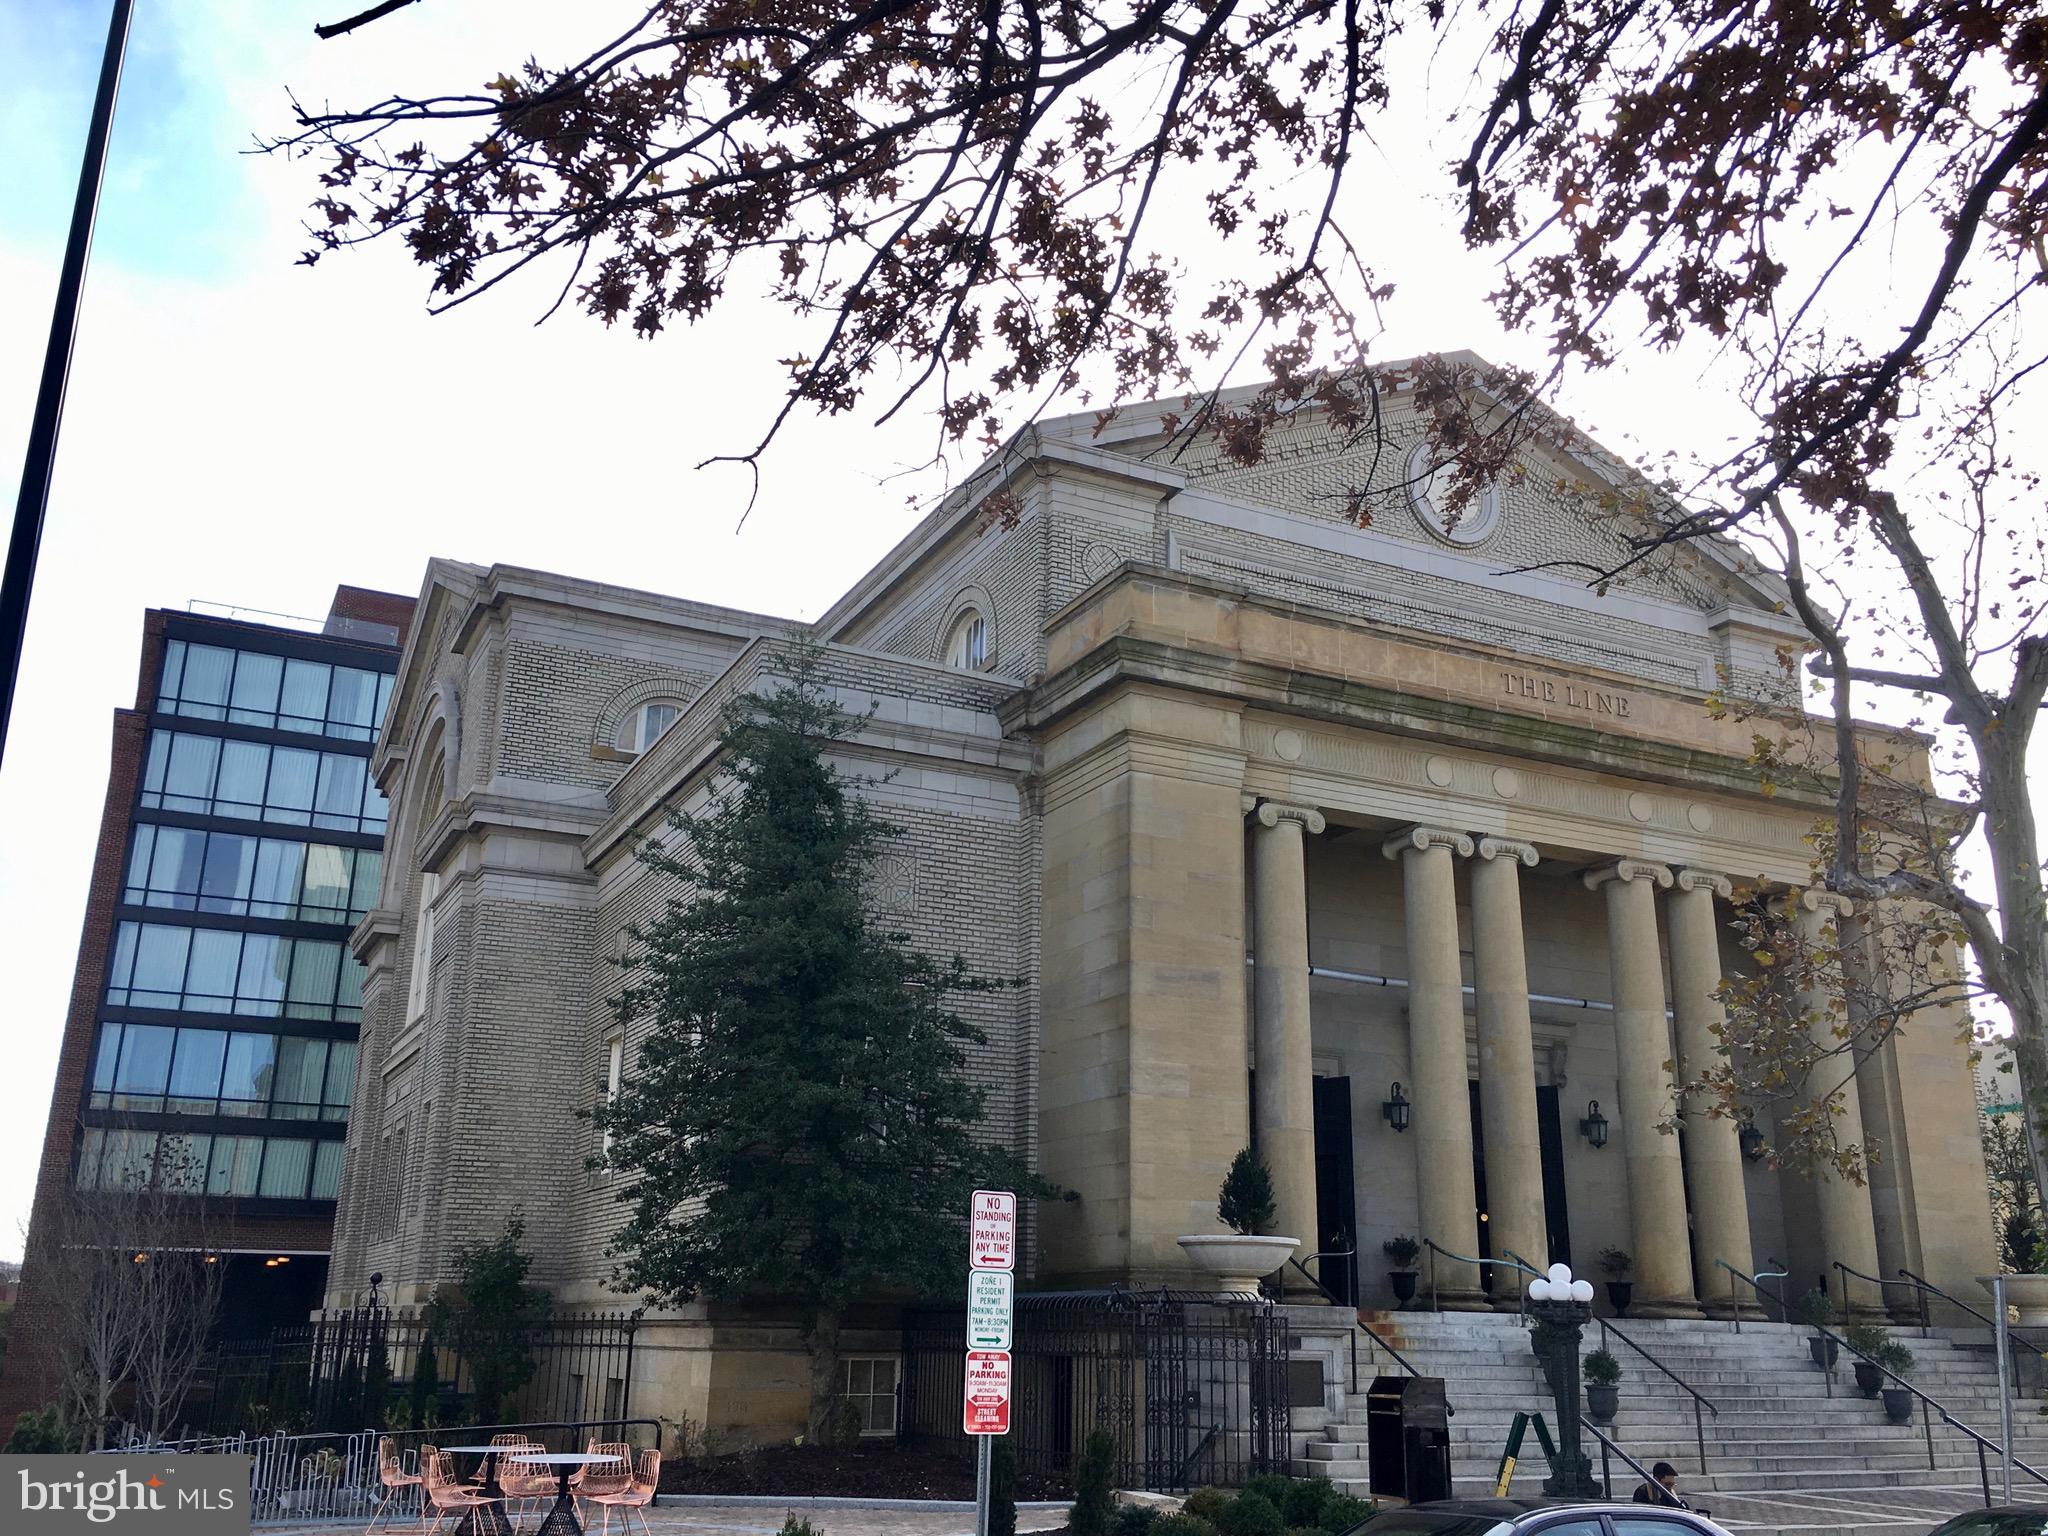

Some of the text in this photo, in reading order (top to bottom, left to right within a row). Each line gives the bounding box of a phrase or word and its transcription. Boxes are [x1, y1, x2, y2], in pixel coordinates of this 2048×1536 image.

[1501, 672, 1631, 717] THE LINE
[986, 1197, 1001, 1210] NO
[975, 1210, 1012, 1222] STANDING
[975, 1230, 1011, 1242] PARKING
[975, 1242, 1010, 1254] ANY TIME
[981, 1277, 997, 1286] ZONE
[976, 1286, 1005, 1296] RESIDENT
[980, 1297, 1001, 1305] PERMIT
[971, 1306, 1009, 1316] PARKING ONLY
[982, 1361, 995, 1370] NO
[969, 1370, 1007, 1379] PARKING
[977, 1408, 997, 1416] STREET
[974, 1415, 1000, 1423] CLEANING
